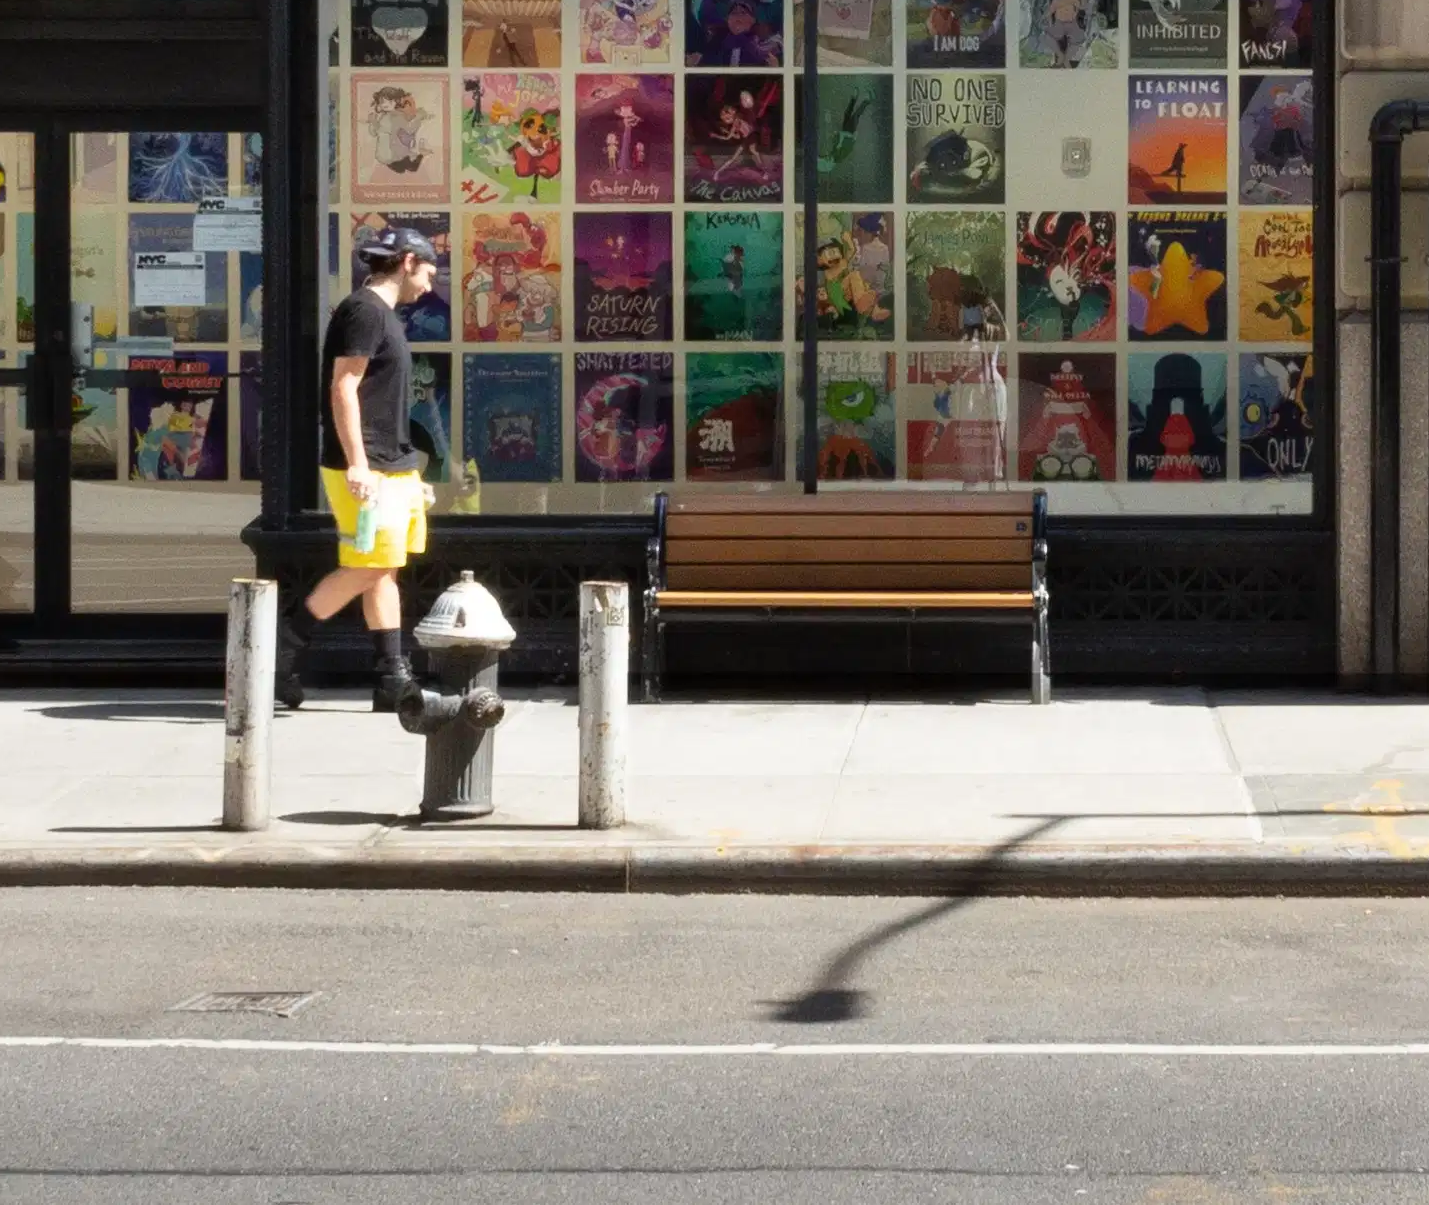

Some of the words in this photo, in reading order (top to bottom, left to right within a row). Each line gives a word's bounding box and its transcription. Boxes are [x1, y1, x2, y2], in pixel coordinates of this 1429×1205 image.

[1136, 24, 1221, 39] INHIBITED
[940, 35, 957, 52] AM
[959, 35, 980, 52] DOG
[912, 77, 942, 102] NO
[954, 77, 998, 102] ONE
[1135, 80, 1221, 94] LEARNING
[906, 101, 1006, 127] SURVIVED
[1134, 99, 1152, 109] TO
[1158, 102, 1224, 118] FLOAT
[589, 179, 630, 198] Slumber
[632, 179, 661, 200] Party
[719, 181, 781, 203] Canvas
[200, 200, 225, 209] NYC
[138, 255, 166, 264] NYC
[587, 294, 664, 317] SATURN
[586, 315, 660, 339] RISING
[576, 352, 672, 371] SHATTERED
